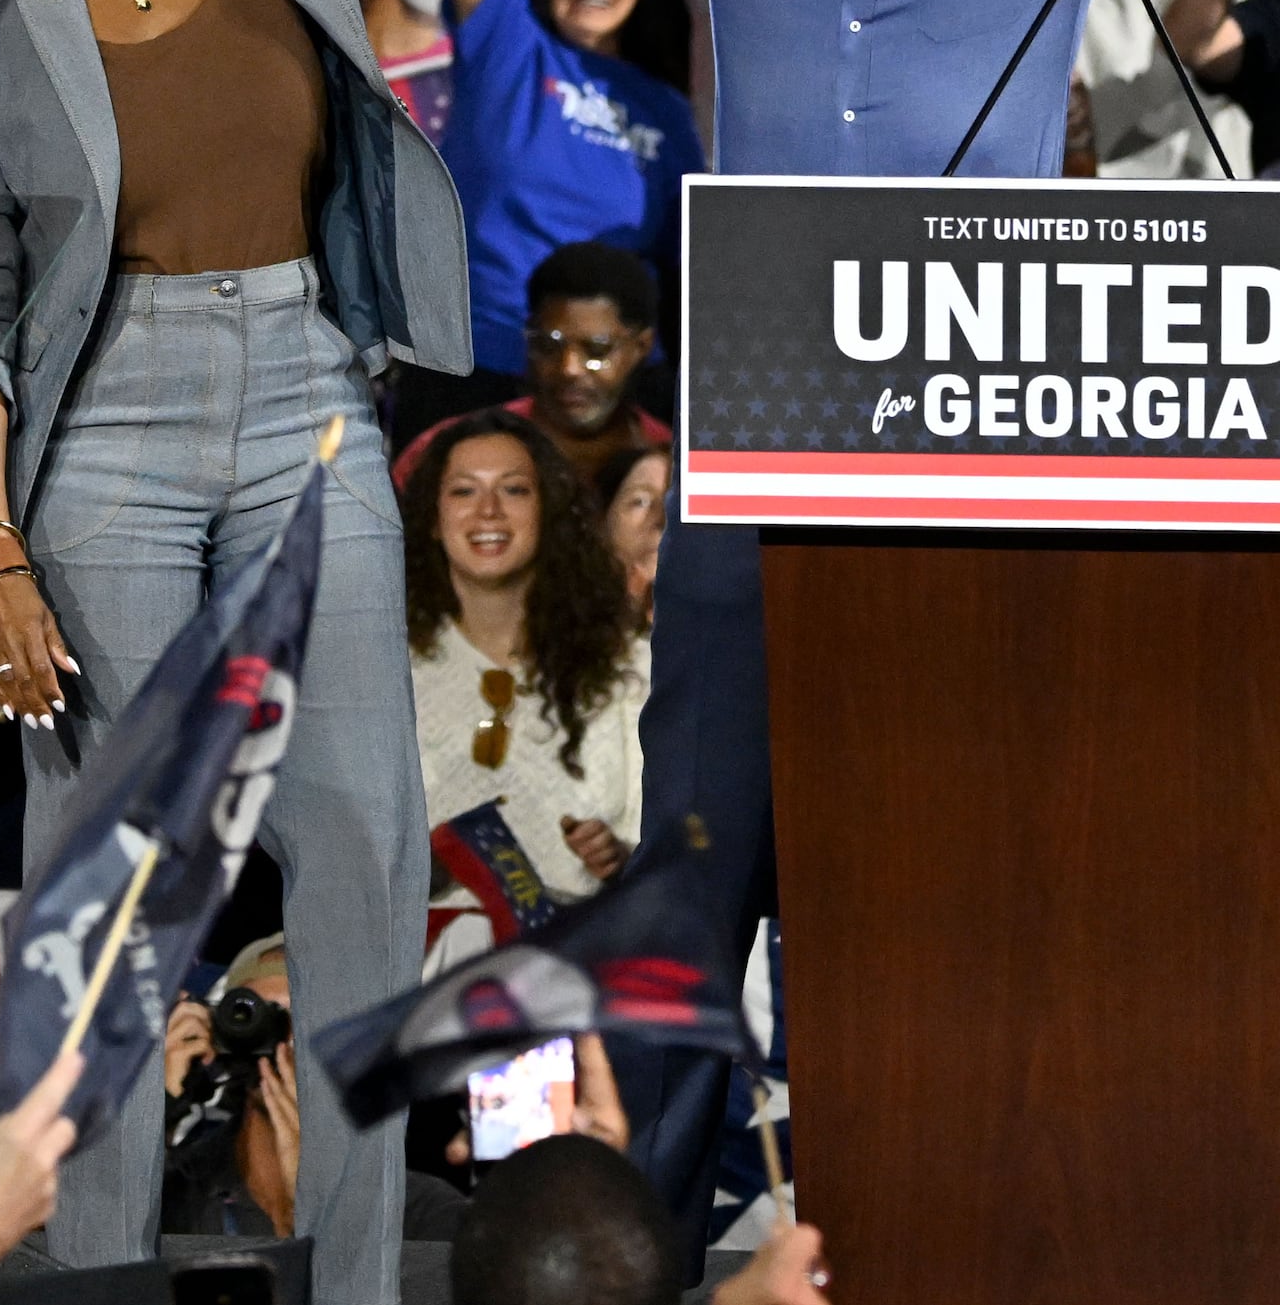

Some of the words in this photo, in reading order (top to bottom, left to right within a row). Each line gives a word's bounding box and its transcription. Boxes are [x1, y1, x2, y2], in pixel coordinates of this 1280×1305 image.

[924, 217, 986, 241] TEXT
[994, 218, 1089, 242] UNITED
[1095, 219, 1128, 242] TO
[1133, 220, 1208, 244] 51015
[872, 388, 916, 434] for
[923, 374, 1268, 441] GEORGIA
